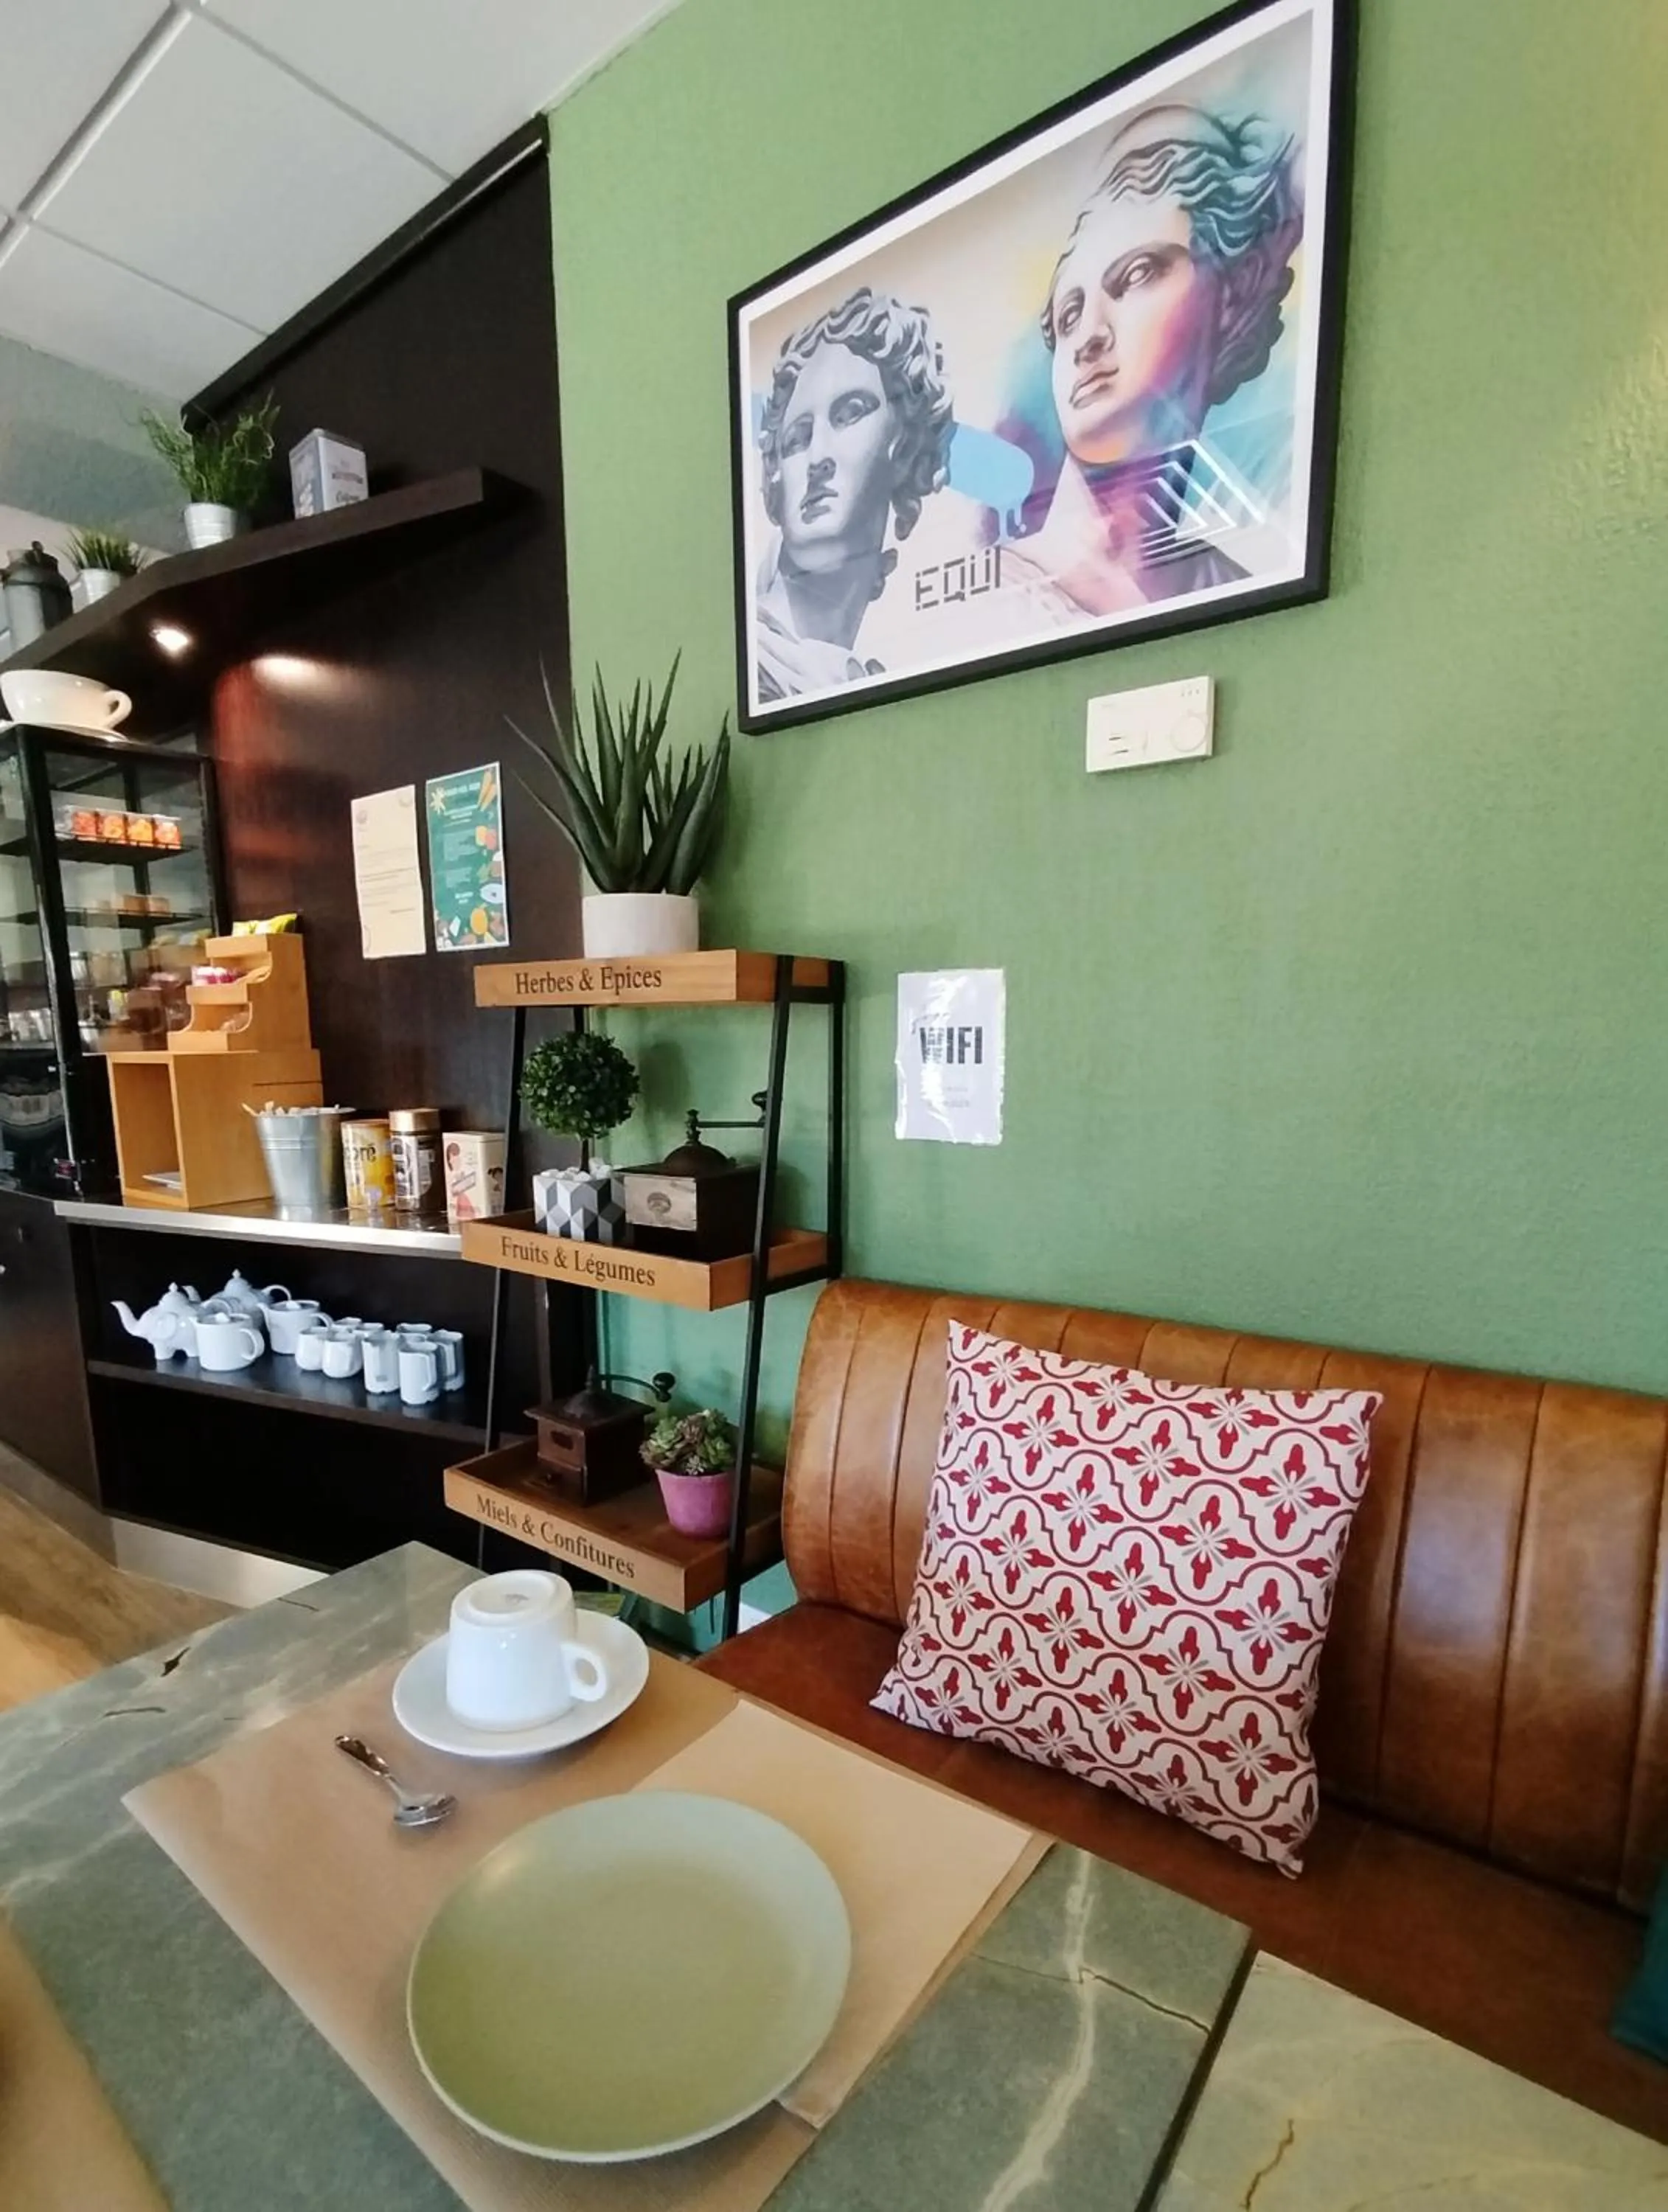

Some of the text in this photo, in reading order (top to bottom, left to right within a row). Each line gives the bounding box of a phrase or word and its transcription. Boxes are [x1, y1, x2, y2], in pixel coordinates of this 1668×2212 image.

[915, 544, 1001, 611] EQUI
[515, 965, 661, 995] Herbes & Epices
[920, 1026, 983, 1063] WIFI
[501, 1236, 656, 1287] Fruits & Légumes
[476, 1493, 635, 1579] Miels & Confitures
